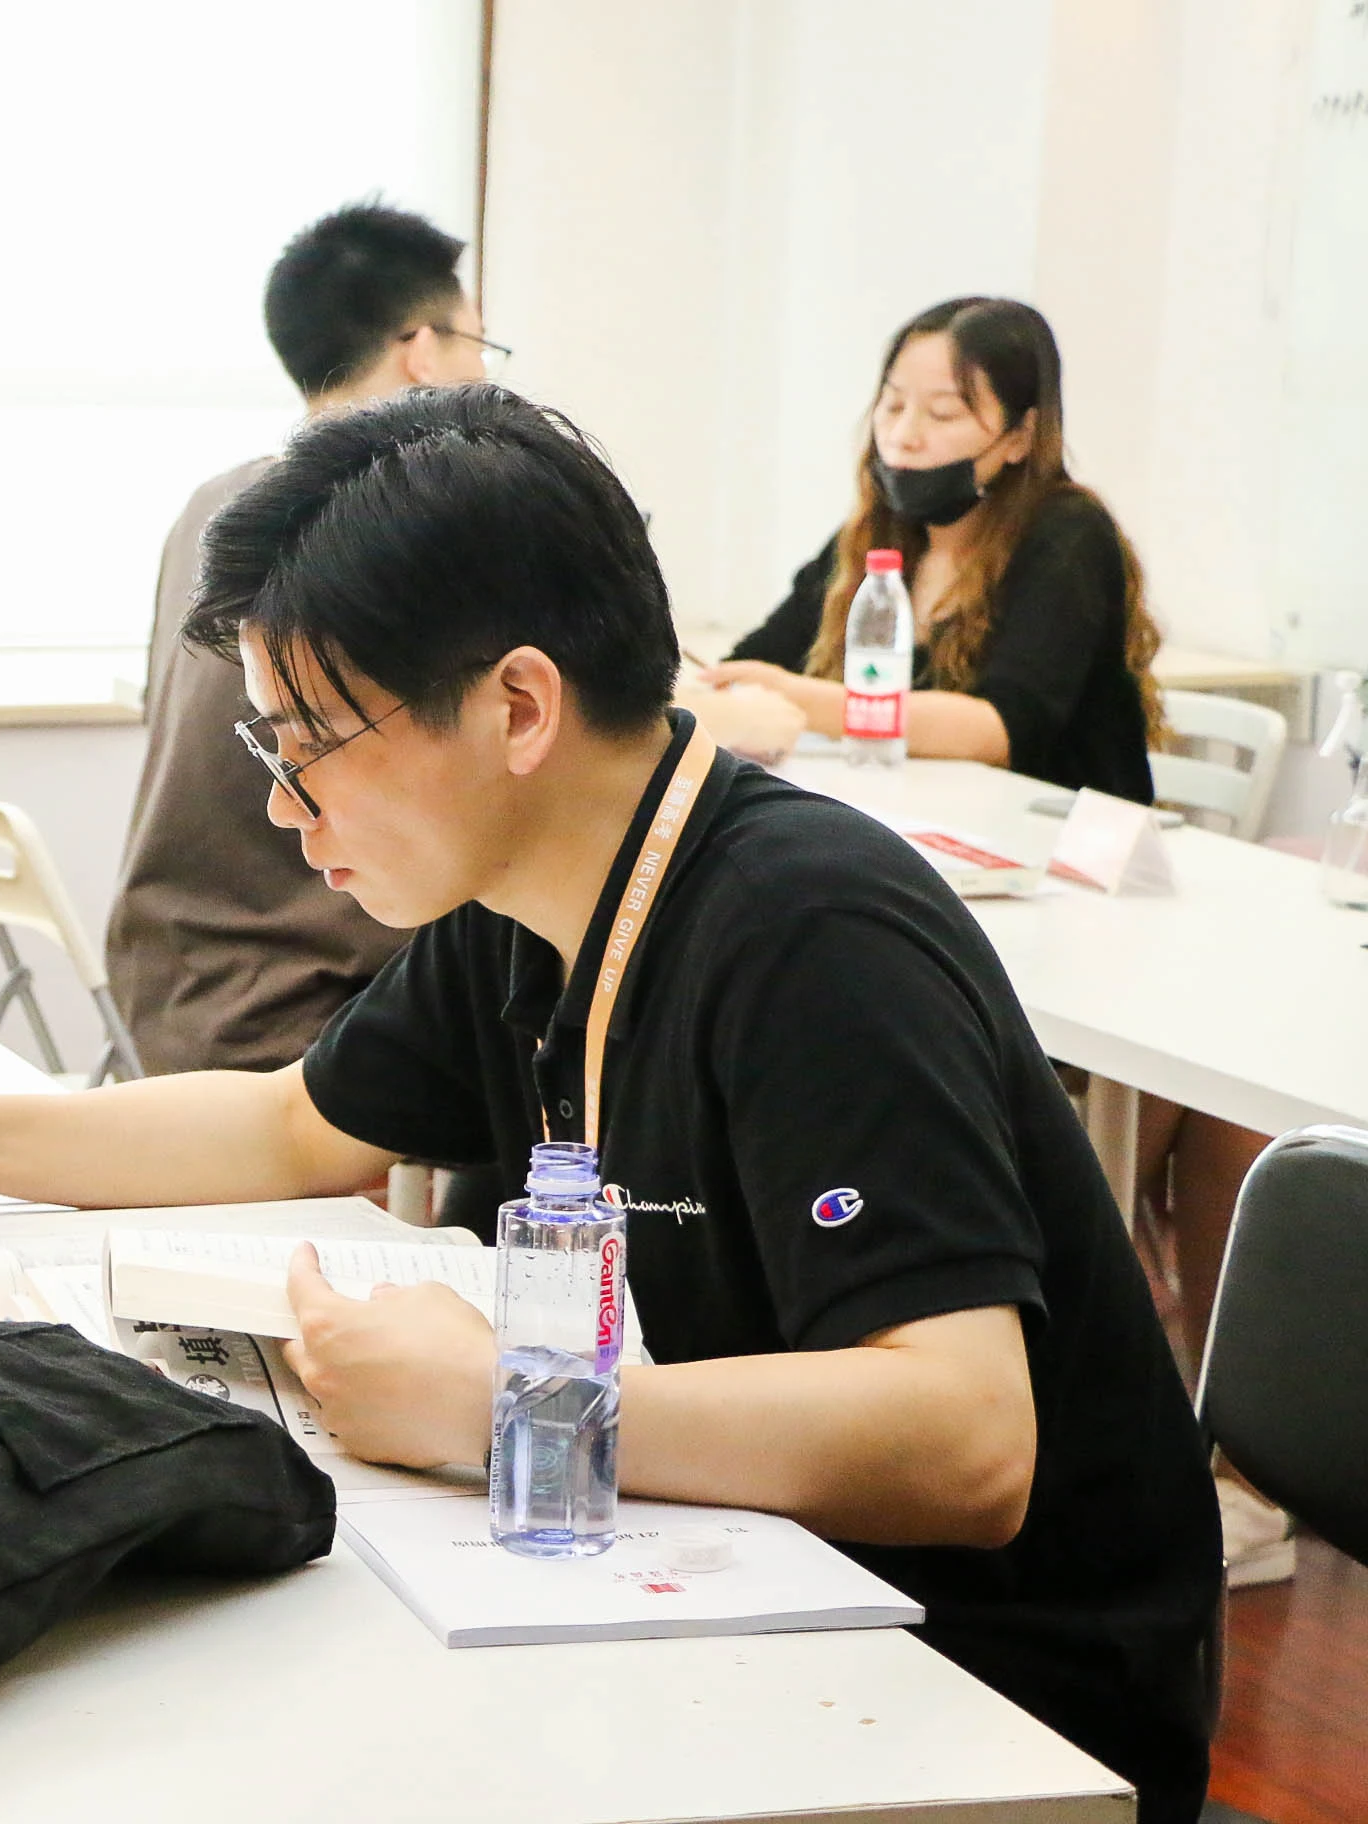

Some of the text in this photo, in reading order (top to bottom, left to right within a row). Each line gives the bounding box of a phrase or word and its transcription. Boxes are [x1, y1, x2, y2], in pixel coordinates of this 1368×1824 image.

[602, 850, 662, 993] NEVER GIVE UP
